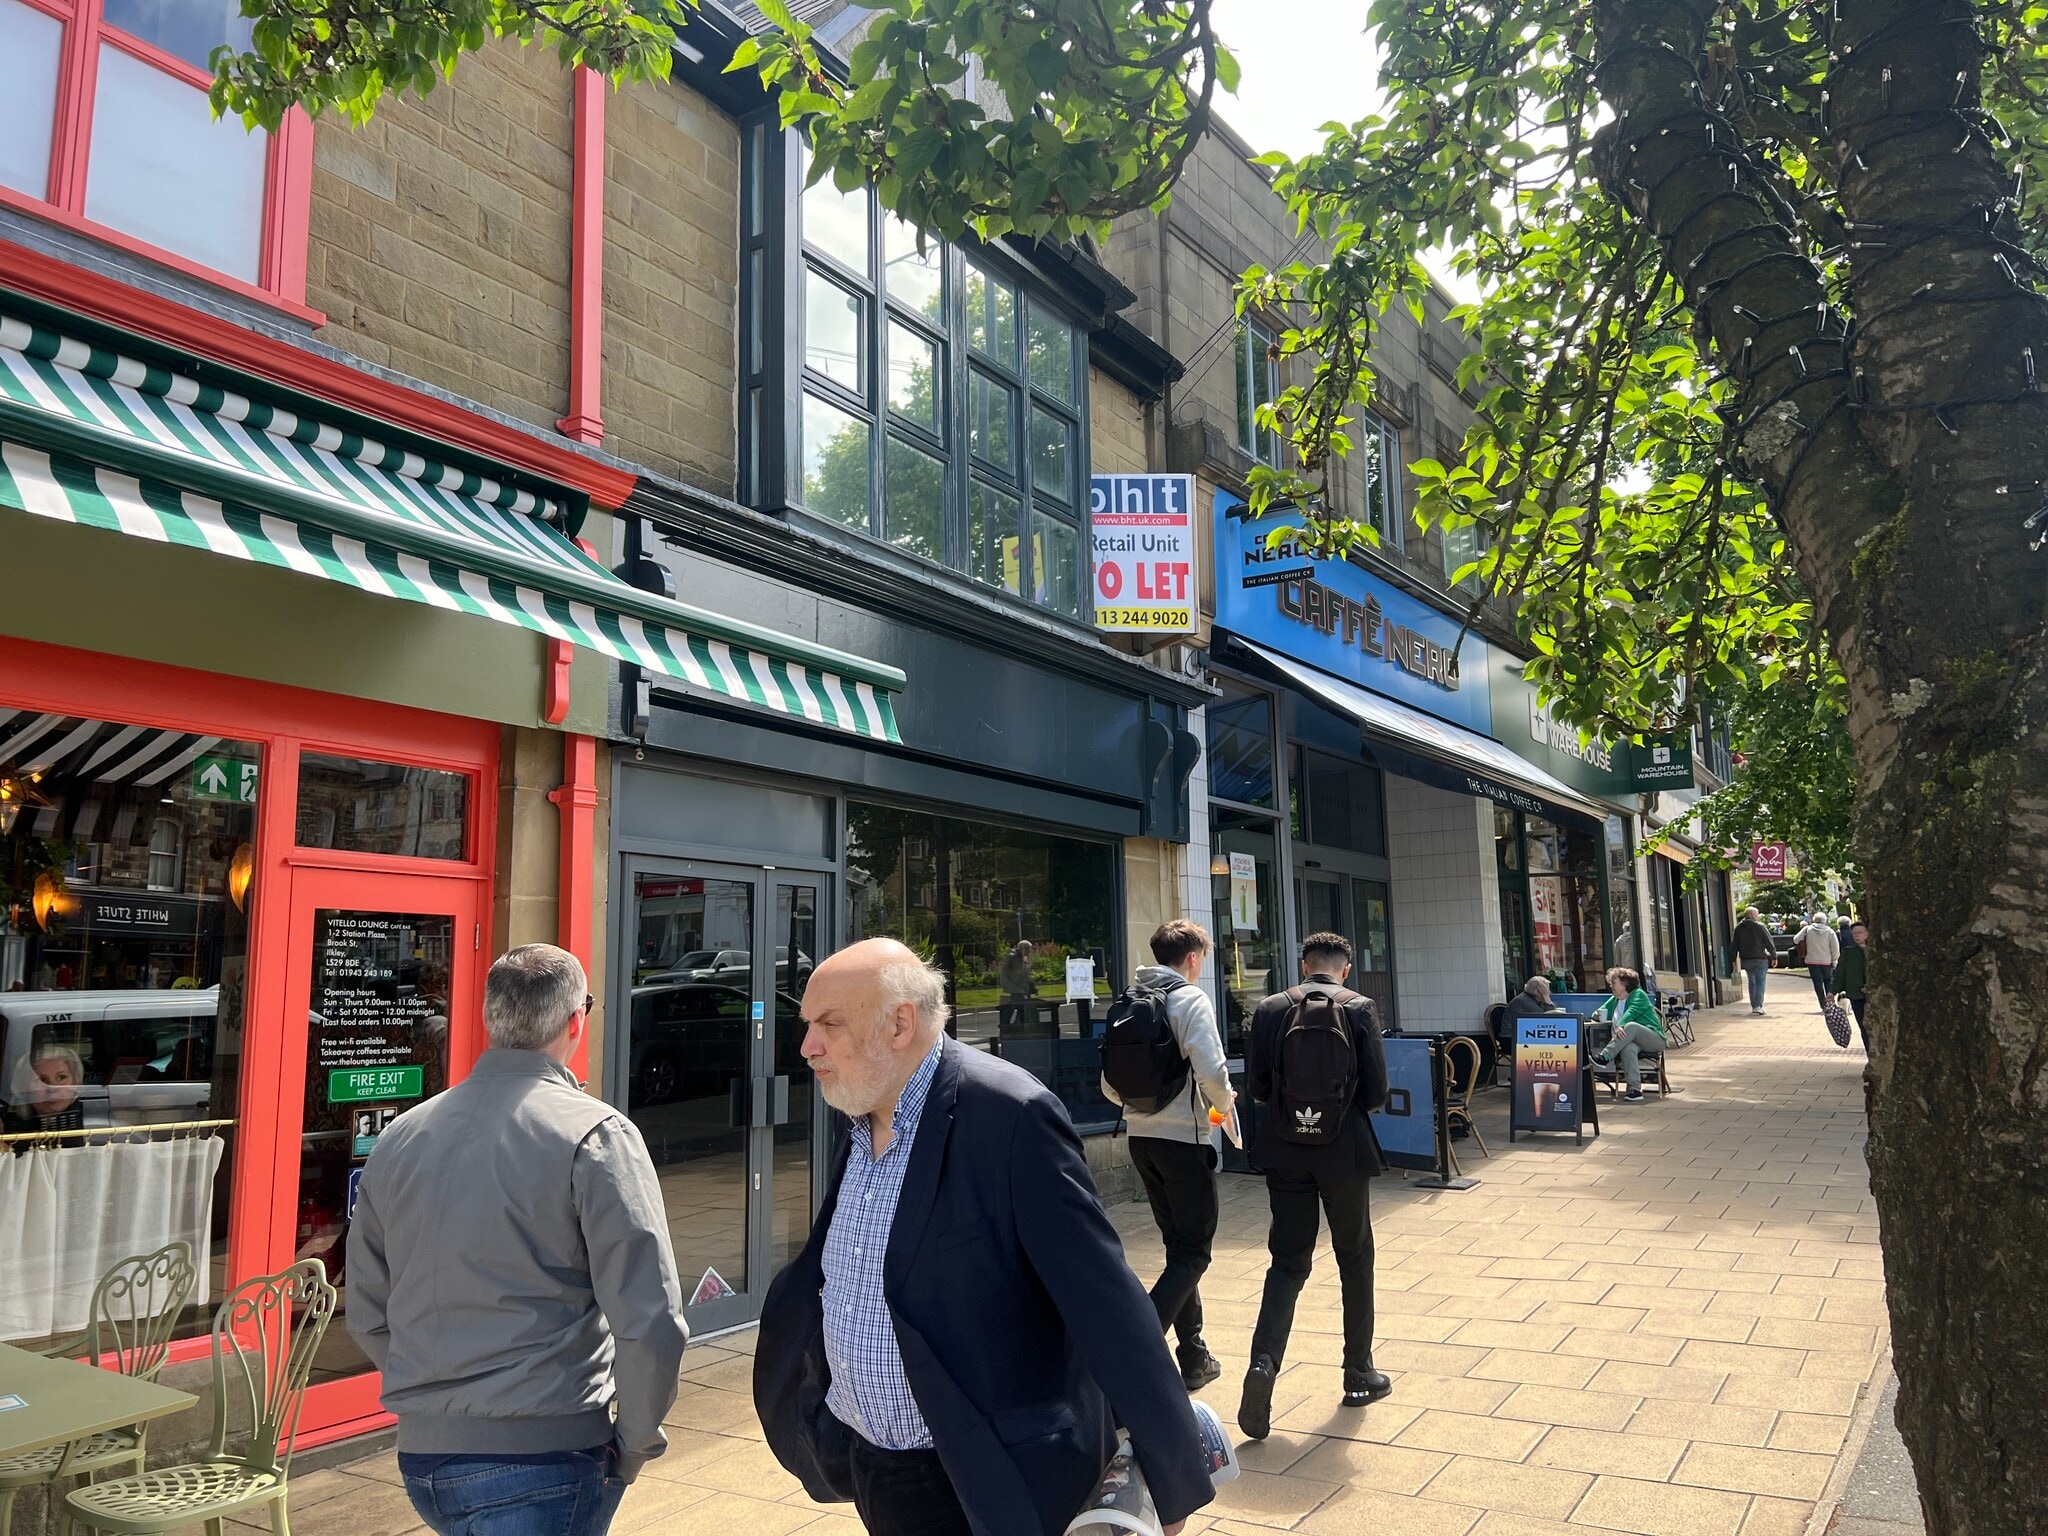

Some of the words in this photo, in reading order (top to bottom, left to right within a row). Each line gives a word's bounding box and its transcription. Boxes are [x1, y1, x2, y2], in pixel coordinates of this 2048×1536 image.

[1094, 516, 1170, 524] www.bht.uk.com
[1142, 534, 1179, 552] Unit
[1280, 572, 1300, 580] COFFEE
[1136, 562, 1188, 600] LET
[1095, 611, 1118, 624] 113
[1122, 611, 1148, 624] 244
[1152, 612, 1188, 625] 9020
[1385, 618, 1460, 690] NERO
[1642, 764, 1684, 773] MOUNTAIN
[1637, 770, 1690, 779] WAREHOUSE
[1466, 778, 1482, 792] THE
[1483, 783, 1508, 801] ITALIAN
[1510, 792, 1532, 810] COFFEE
[328, 919, 356, 928] VITELLO
[358, 920, 388, 929] LOUNGE
[368, 931, 387, 939] Plaza,
[327, 949, 346, 958] Ilkley,
[324, 988, 354, 997] Opening
[398, 999, 426, 1007] 11.00pm
[407, 1008, 435, 1017] midnight
[322, 1018, 338, 1027] (Last
[382, 1018, 413, 1026] 10.00pm)
[1526, 1030, 1568, 1038] NERO
[356, 1037, 386, 1045] available
[321, 1048, 355, 1056] Takeaway
[357, 1047, 380, 1055] coffees
[382, 1046, 412, 1054] available
[320, 1057, 397, 1066] www.thelounges.co.uk
[1526, 1060, 1568, 1072] VELVET
[350, 1073, 375, 1088] FIRE
[380, 1072, 404, 1086] EXIT
[357, 1088, 374, 1096] KEEP
[376, 1086, 396, 1095] CLEAR
